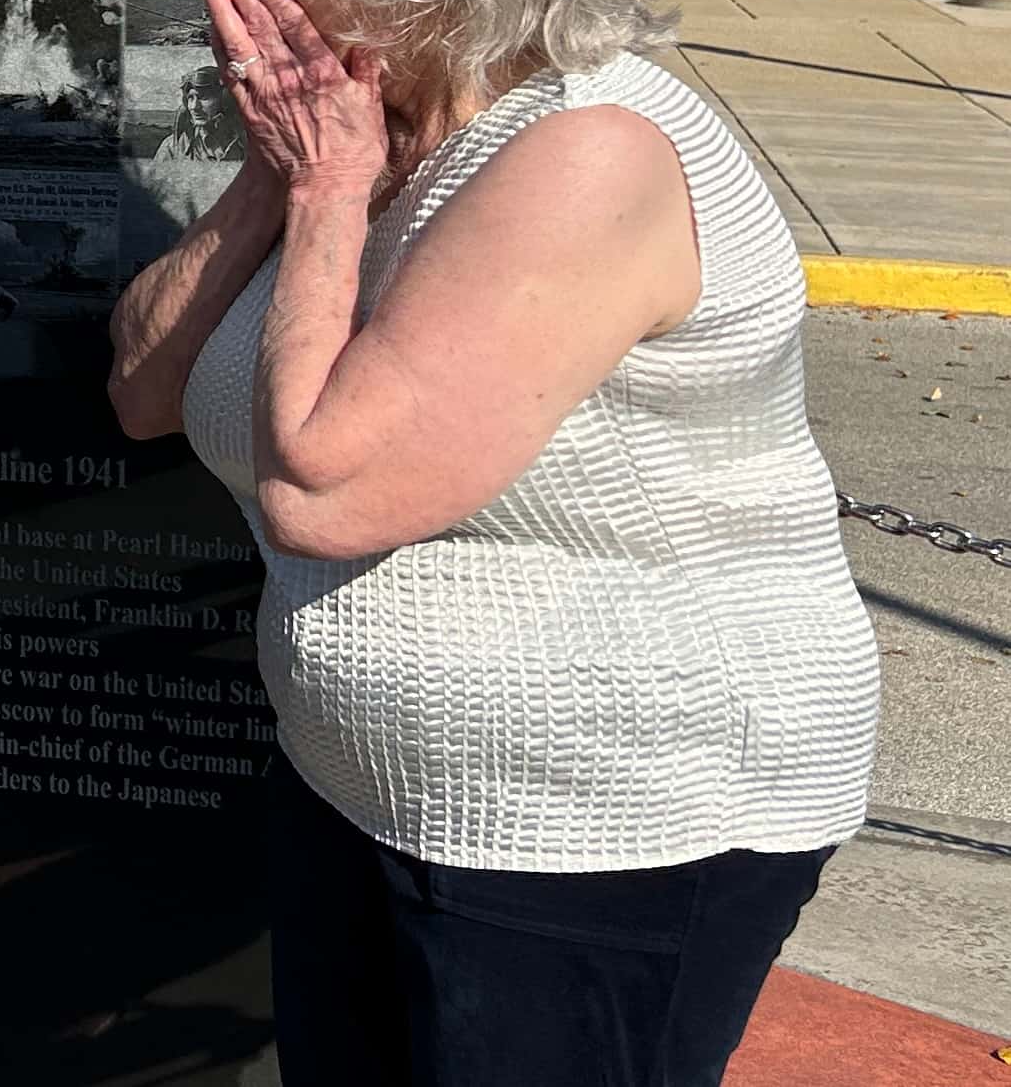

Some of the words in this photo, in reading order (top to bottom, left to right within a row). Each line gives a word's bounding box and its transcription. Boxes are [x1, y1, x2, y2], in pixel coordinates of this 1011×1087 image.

[61, 454, 131, 490] 1941
[17, 523, 67, 548] base
[73, 528, 93, 551] at
[103, 529, 161, 555] Pearl
[32, 558, 109, 588] United
[114, 564, 183, 593] States
[93, 598, 193, 629] Franklin
[202, 606, 226, 632] D.
[19, 632, 101, 658] powers
[20, 669, 64, 690] war
[69, 672, 97, 692] on
[103, 670, 139, 697] the
[145, 673, 222, 703] United
[228, 680, 269, 706] Sta
[61, 703, 84, 726] to
[90, 704, 145, 731] form
[246, 717, 276, 743] lin
[89, 739, 114, 764] of
[117, 741, 153, 767] the
[158, 746, 253, 776] German
[48, 775, 71, 795] to
[77, 774, 112, 799] the
[117, 778, 223, 810] Japanese
